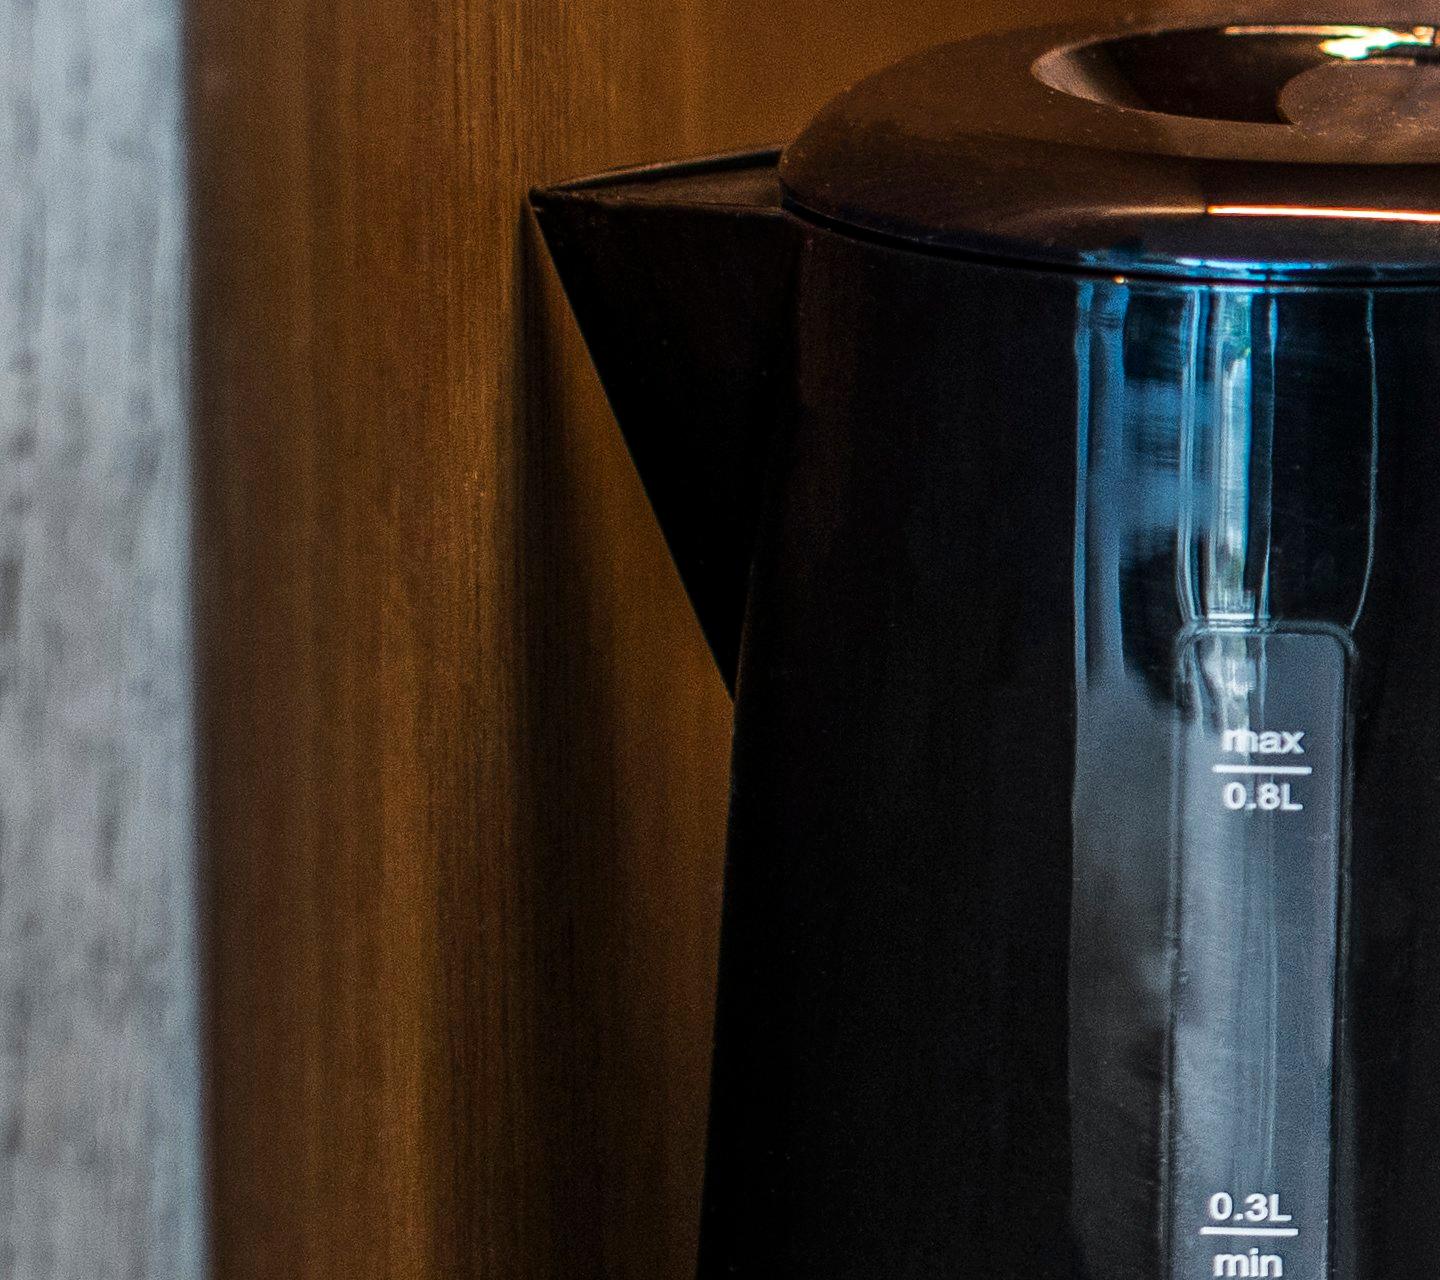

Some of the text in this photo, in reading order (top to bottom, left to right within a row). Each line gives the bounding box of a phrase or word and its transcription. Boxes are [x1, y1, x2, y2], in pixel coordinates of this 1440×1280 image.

[1222, 728, 1305, 754] max
[1222, 782, 1304, 810] 0.8L
[1209, 1192, 1293, 1221] 0.3L
[1213, 1247, 1284, 1278] min
